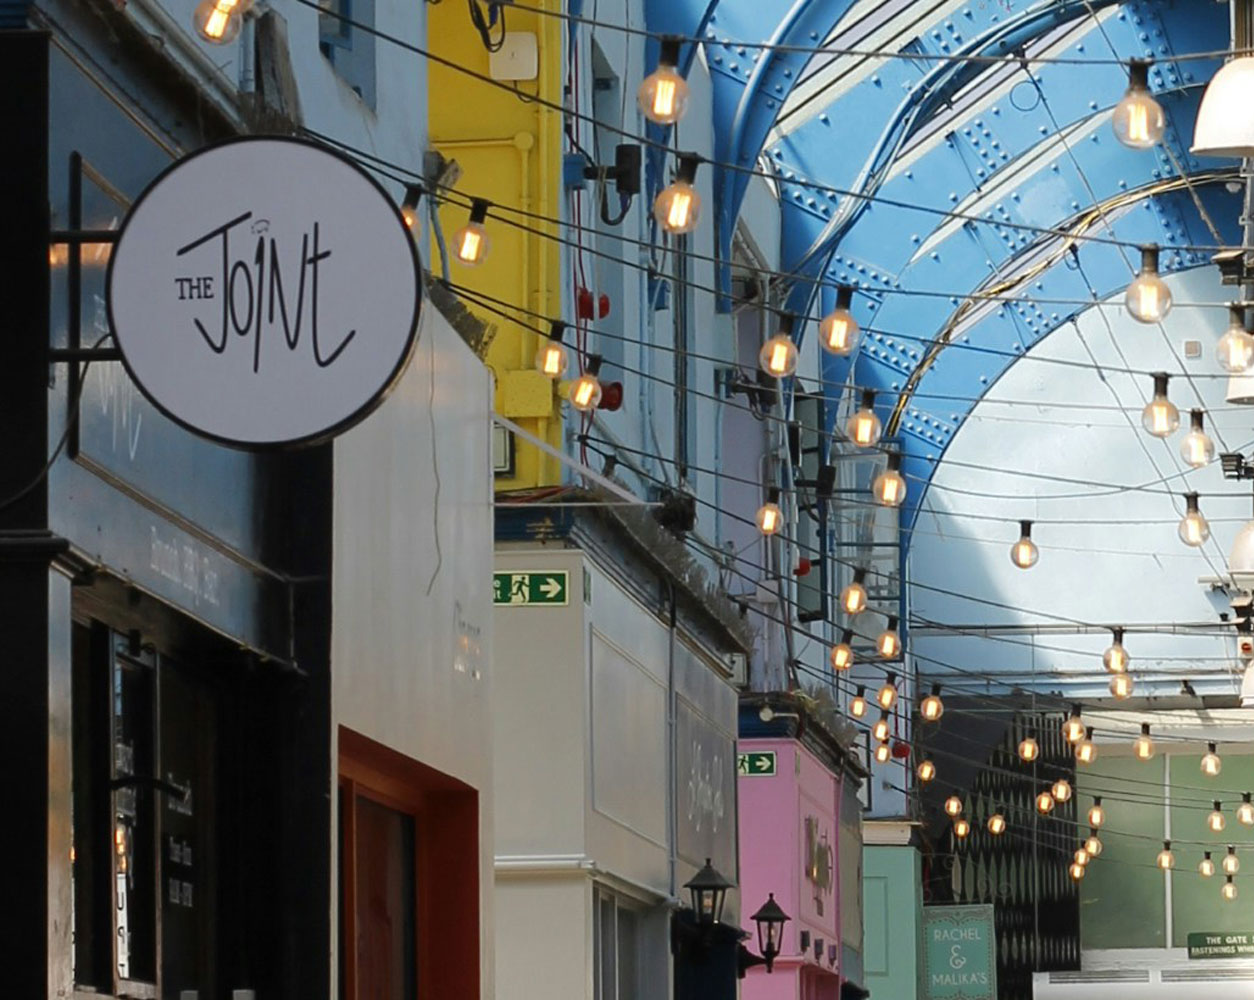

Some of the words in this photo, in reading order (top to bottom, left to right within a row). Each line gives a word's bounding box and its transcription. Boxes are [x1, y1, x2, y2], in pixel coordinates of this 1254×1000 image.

[175, 277, 214, 300] THE
[933, 928, 981, 940] RACHEL
[1226, 936, 1247, 944] GATE
[1191, 946, 1235, 955] FASTENINGS
[950, 945, 966, 969] &
[932, 972, 988, 985] MALIKA'S
